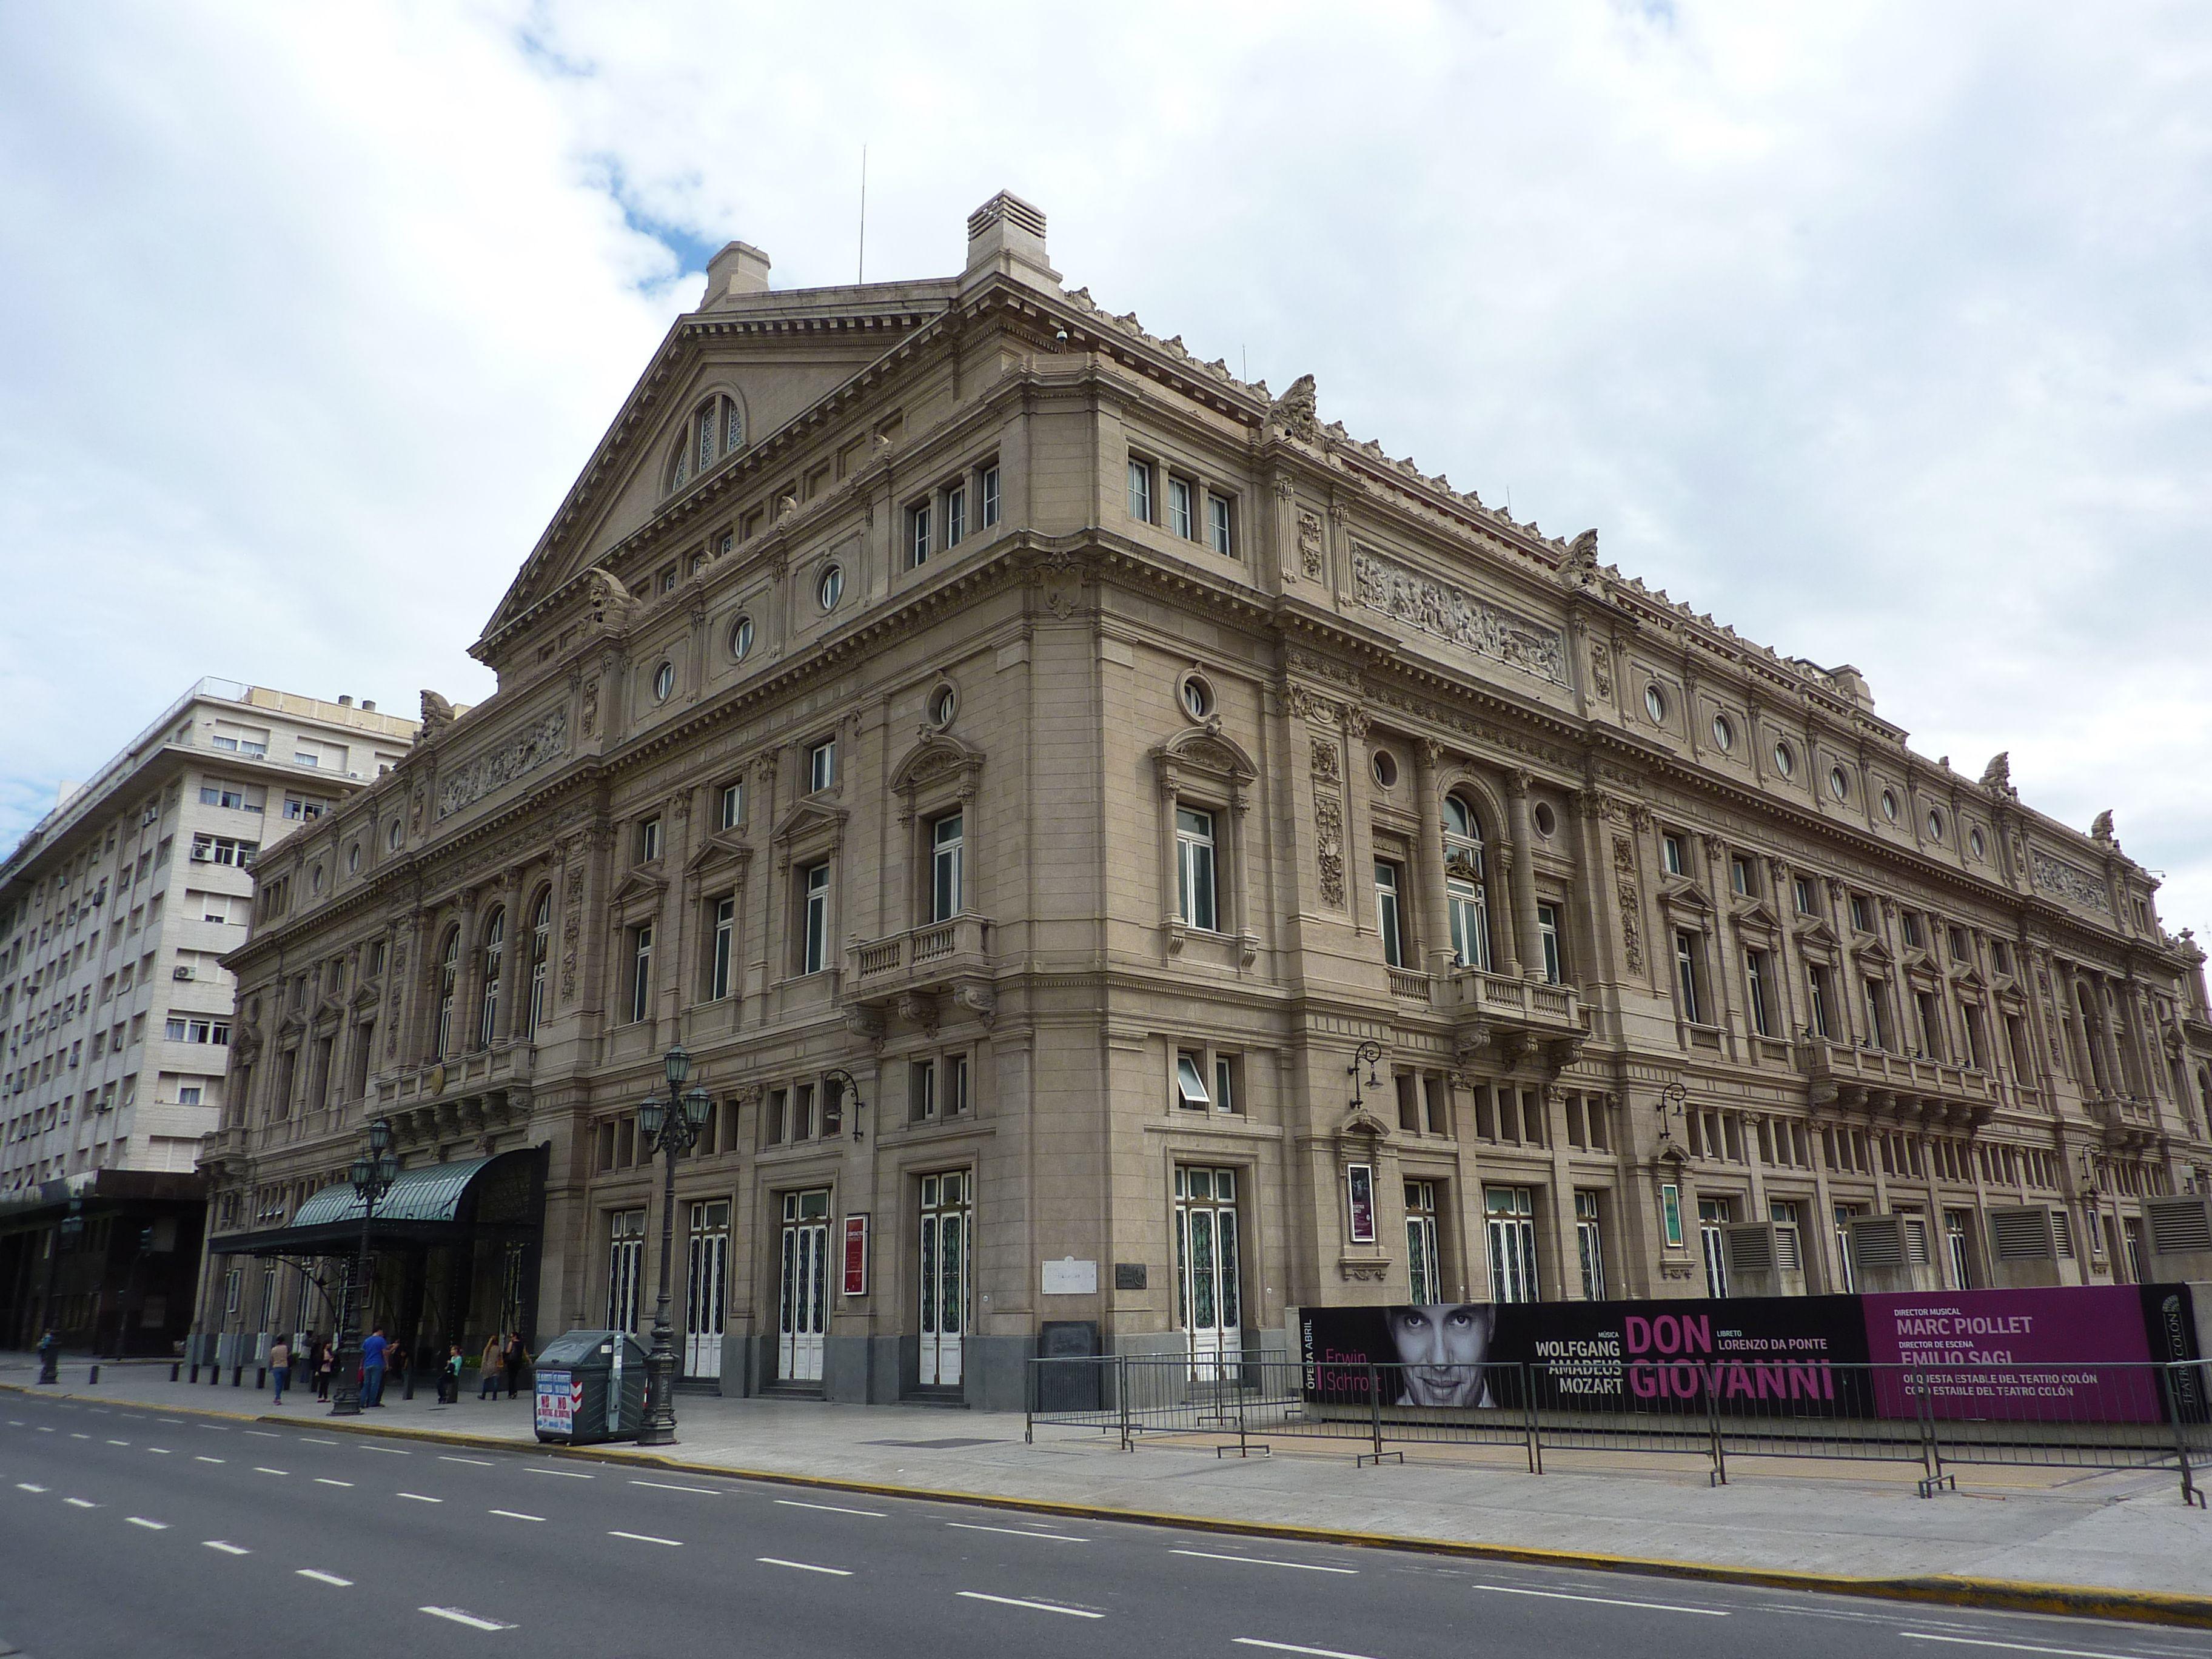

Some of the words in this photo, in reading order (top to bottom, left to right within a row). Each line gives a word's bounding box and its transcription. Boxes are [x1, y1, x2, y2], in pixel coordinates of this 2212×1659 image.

[1897, 1318, 1950, 1335] MARC
[1954, 1316, 2033, 1335] PIOLLET
[1304, 1319, 1313, 1349] ABRIL
[1625, 1314, 1712, 1354] DON
[1535, 1341, 1620, 1357] WOLFGANG
[1718, 1339, 1768, 1350] LORENZO
[1771, 1339, 1787, 1350] DA
[1789, 1338, 1828, 1350] PONTE
[1326, 1349, 1367, 1364] Erwin
[1901, 1351, 1964, 1364] EMILIO
[1968, 1350, 2013, 1364] SAGI
[1549, 1359, 1622, 1375] AMADEUS
[1327, 1372, 1381, 1391] Schrot
[1560, 1378, 1624, 1394] MOZART
[1629, 1358, 1834, 1399] GIOVANNI
[1955, 1373, 1997, 1383] ESTABLE
[1999, 1374, 2018, 1383] DEL
[2019, 1374, 2059, 1383] TEATRO
[2062, 1372, 2098, 1384] COLÓN
[1933, 1386, 1974, 1395] ESTABLE
[1976, 1386, 1995, 1395] DEL
[1996, 1386, 2035, 1395] TEATRO
[541, 1395, 549, 1408] NO
[558, 1396, 566, 1410] NO
